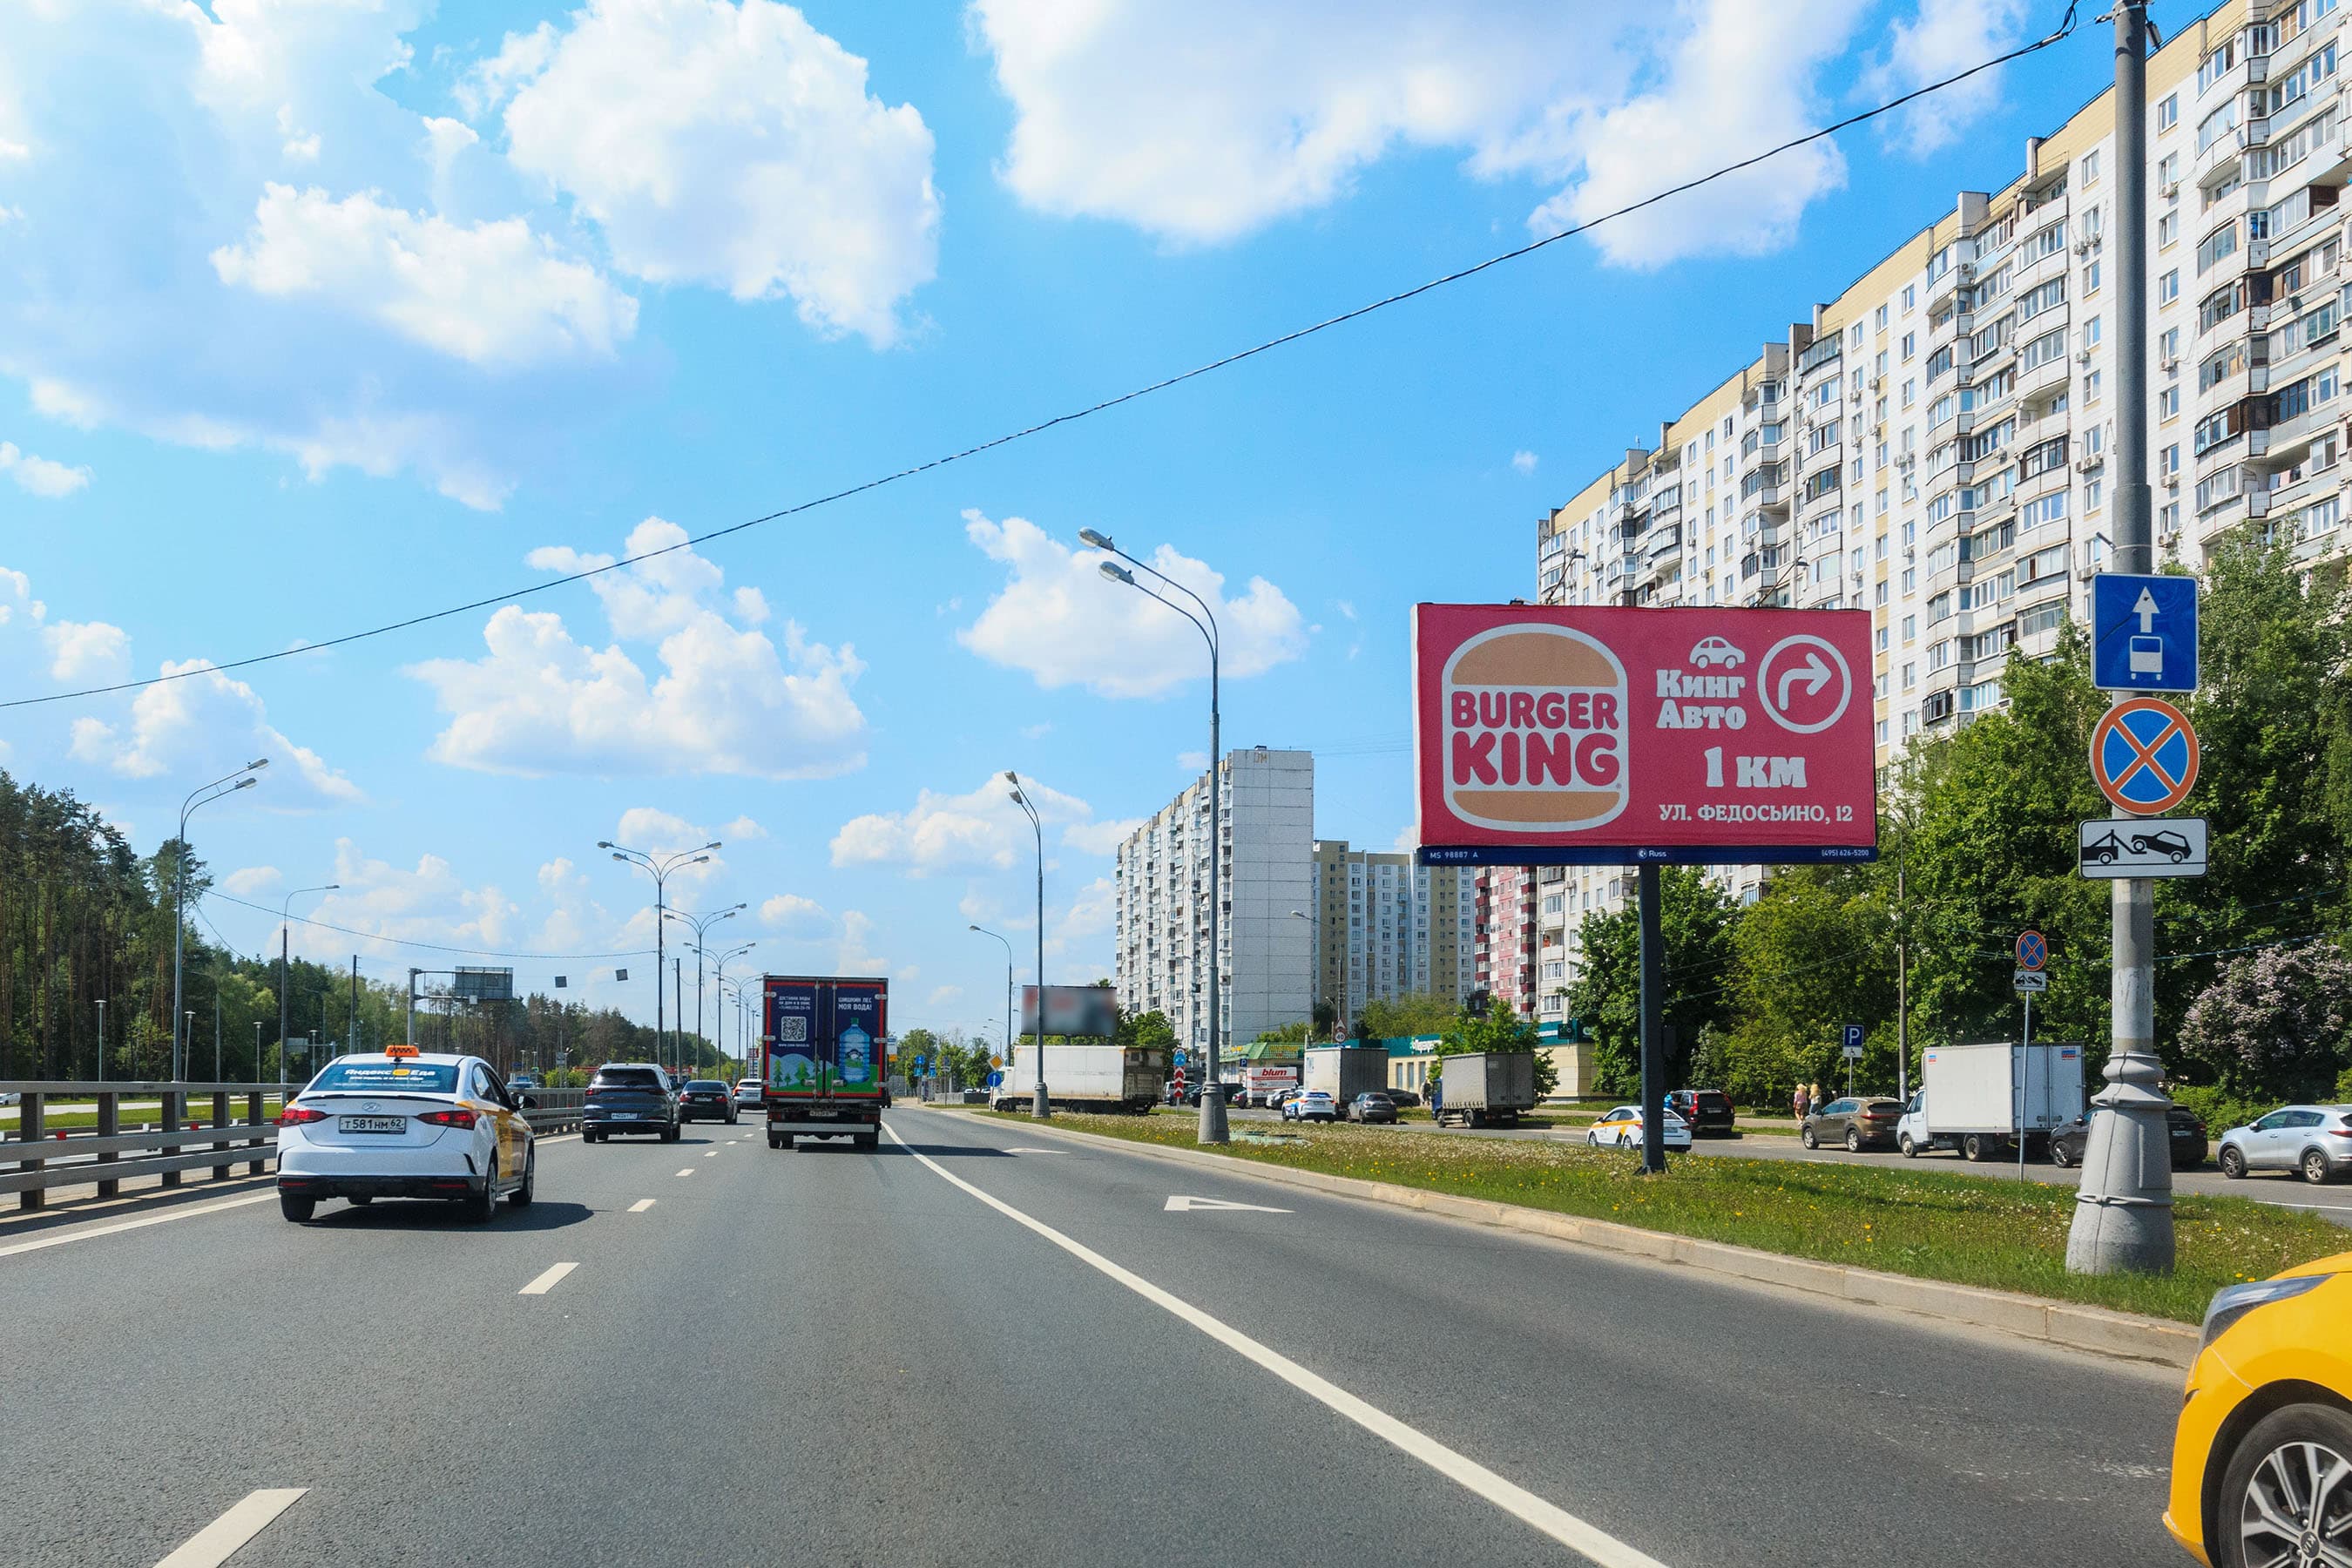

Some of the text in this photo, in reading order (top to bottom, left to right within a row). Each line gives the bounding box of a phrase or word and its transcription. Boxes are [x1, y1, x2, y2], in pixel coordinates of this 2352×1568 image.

[1656, 669, 1746, 698] Кинг
[1451, 691, 1619, 730] BURGER
[1656, 699, 1747, 729] Авто
[1452, 731, 1620, 787] KING
[1704, 747, 1724, 787] 1
[1659, 804, 1853, 824] УЛ. ФЕДОСЬИНО, 12
[1848, 1027, 1860, 1044] P
[1261, 1068, 1288, 1077] blum
